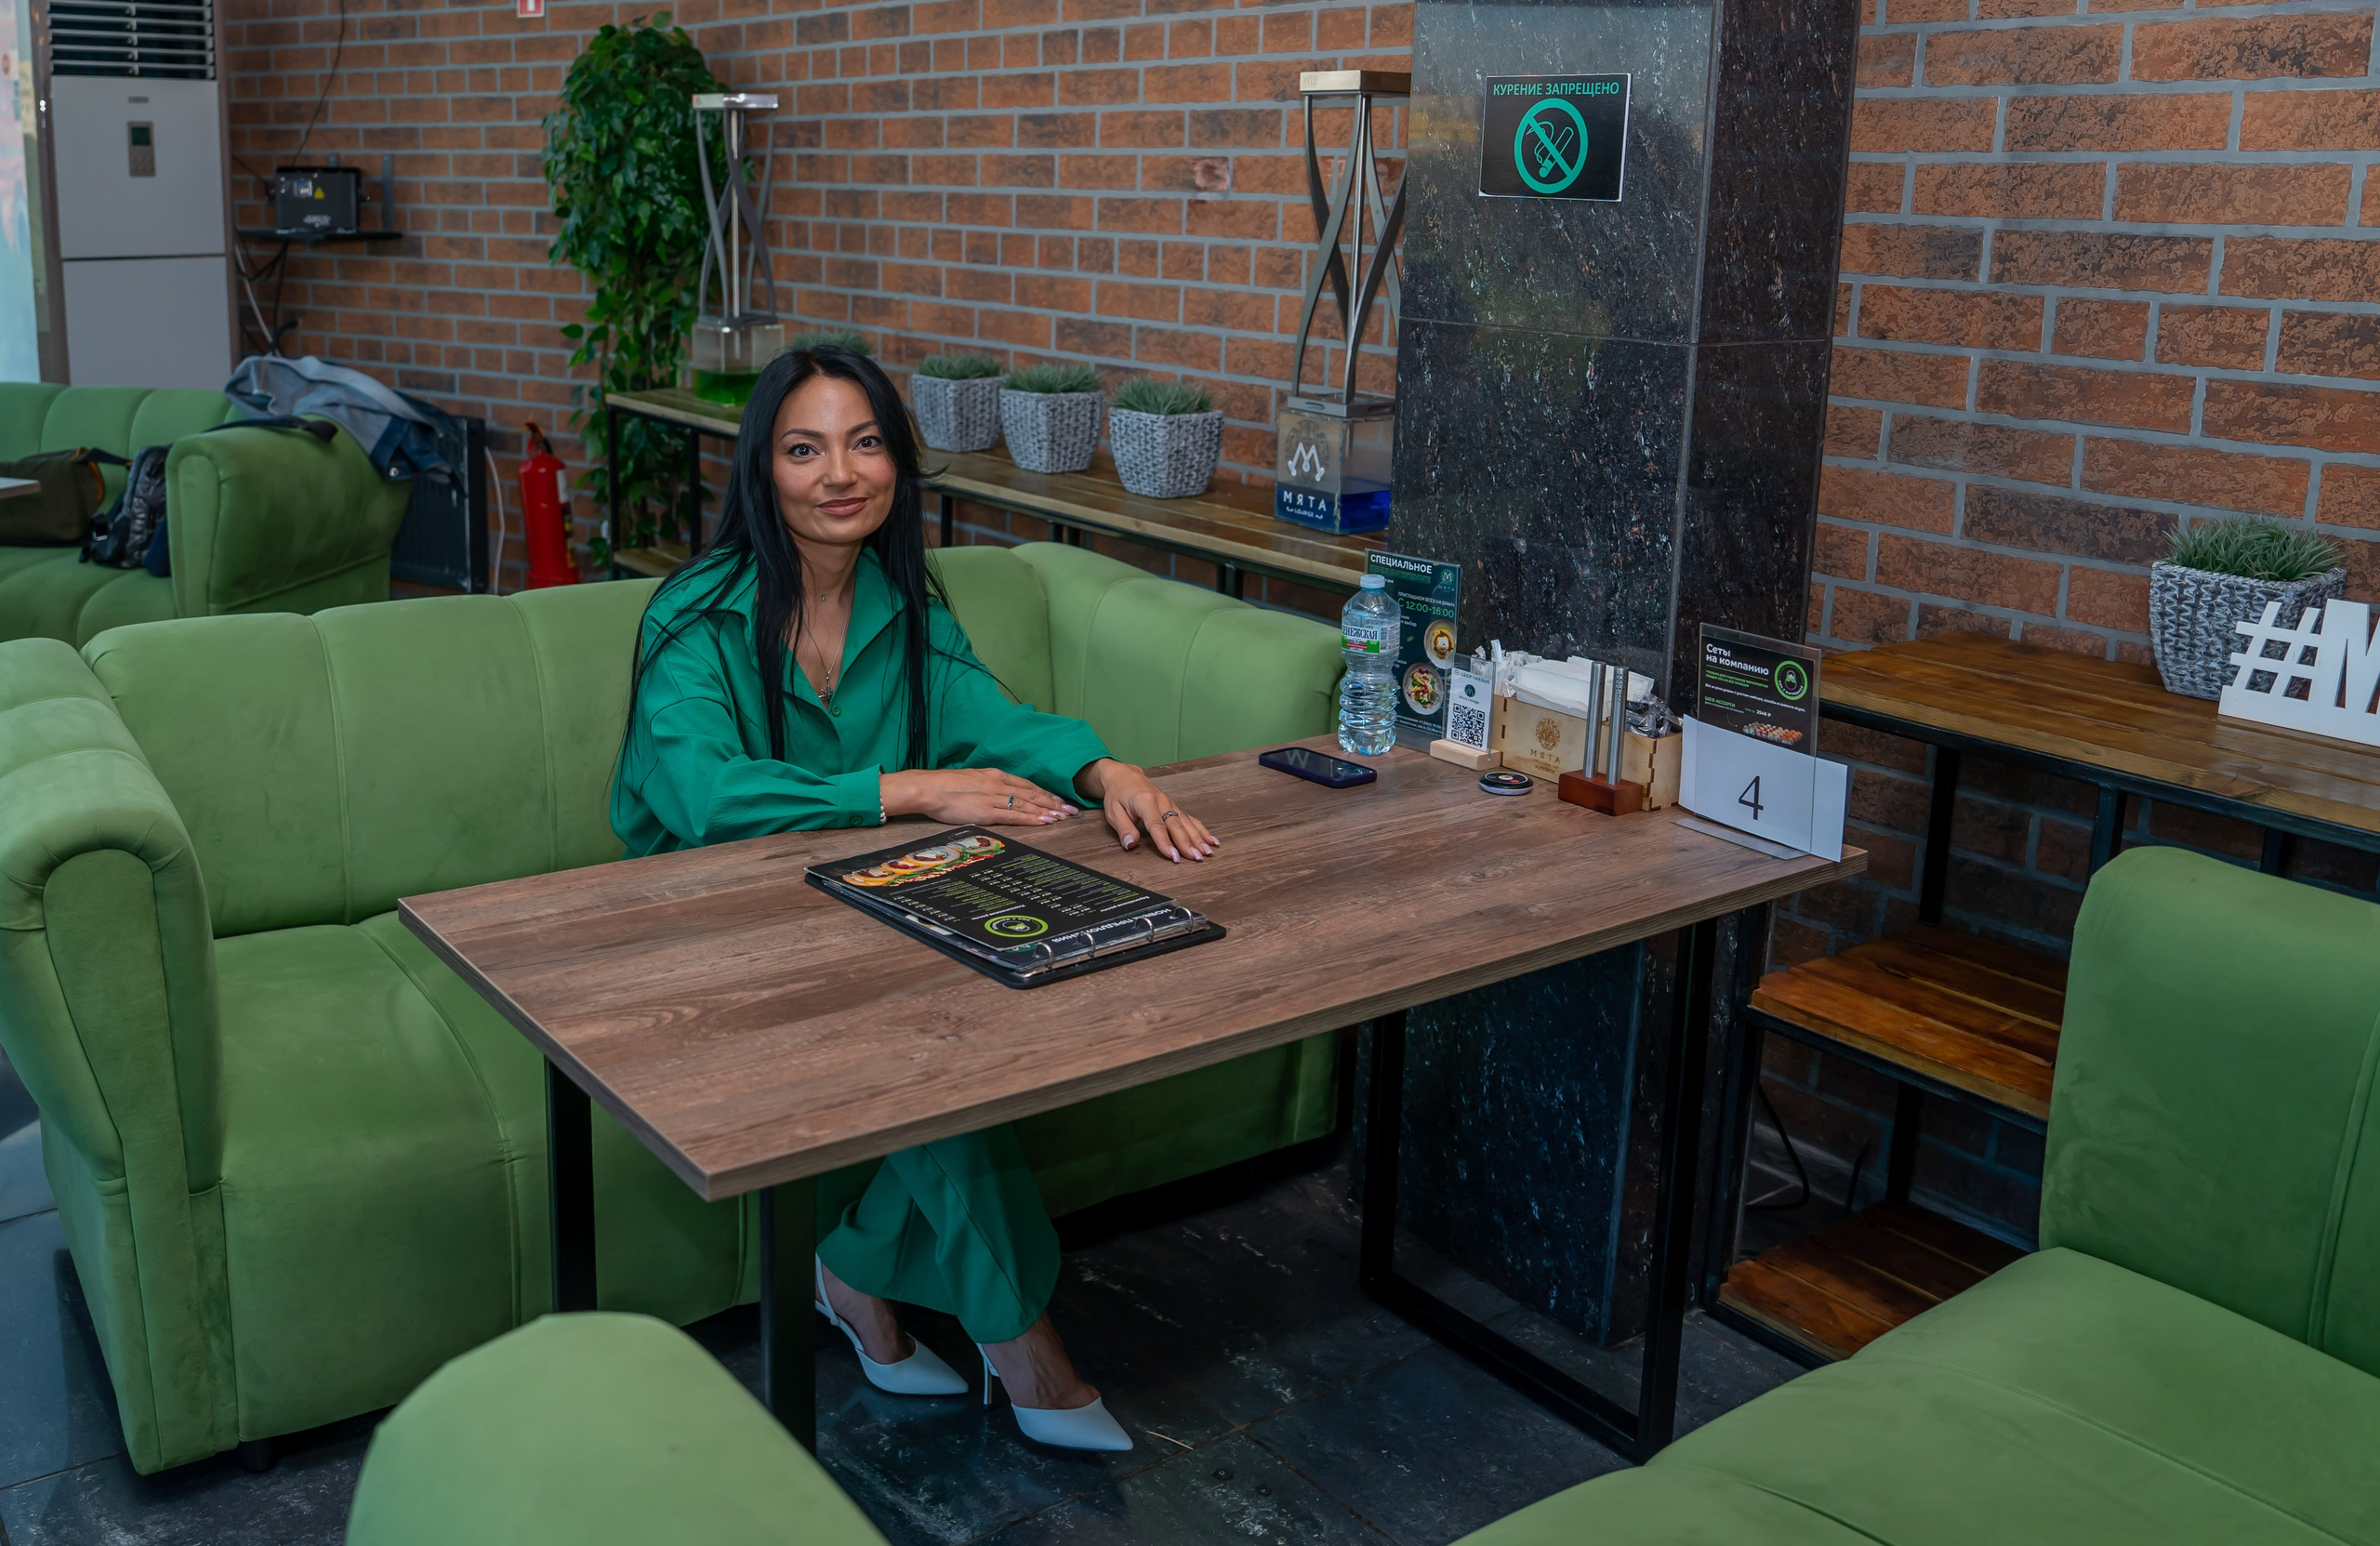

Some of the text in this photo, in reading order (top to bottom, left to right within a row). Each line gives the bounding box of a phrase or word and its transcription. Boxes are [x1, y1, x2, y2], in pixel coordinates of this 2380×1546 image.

[1493, 82, 1620, 97] КУРЕНИЕ ЗАПРЕЩЕНО
[1283, 491, 1327, 511] МЯТА
[1370, 554, 1433, 575] СПЕЦИАЛЬНОЕ
[1406, 601, 1455, 618] 12:00-16:00
[1342, 625, 1378, 641] ЕНЕЖСКАЯ
[1706, 643, 1731, 657] Сеты
[1706, 654, 1769, 675] на компанию
[1530, 748, 1561, 764] МЯТА
[1738, 775, 1765, 821] 4
